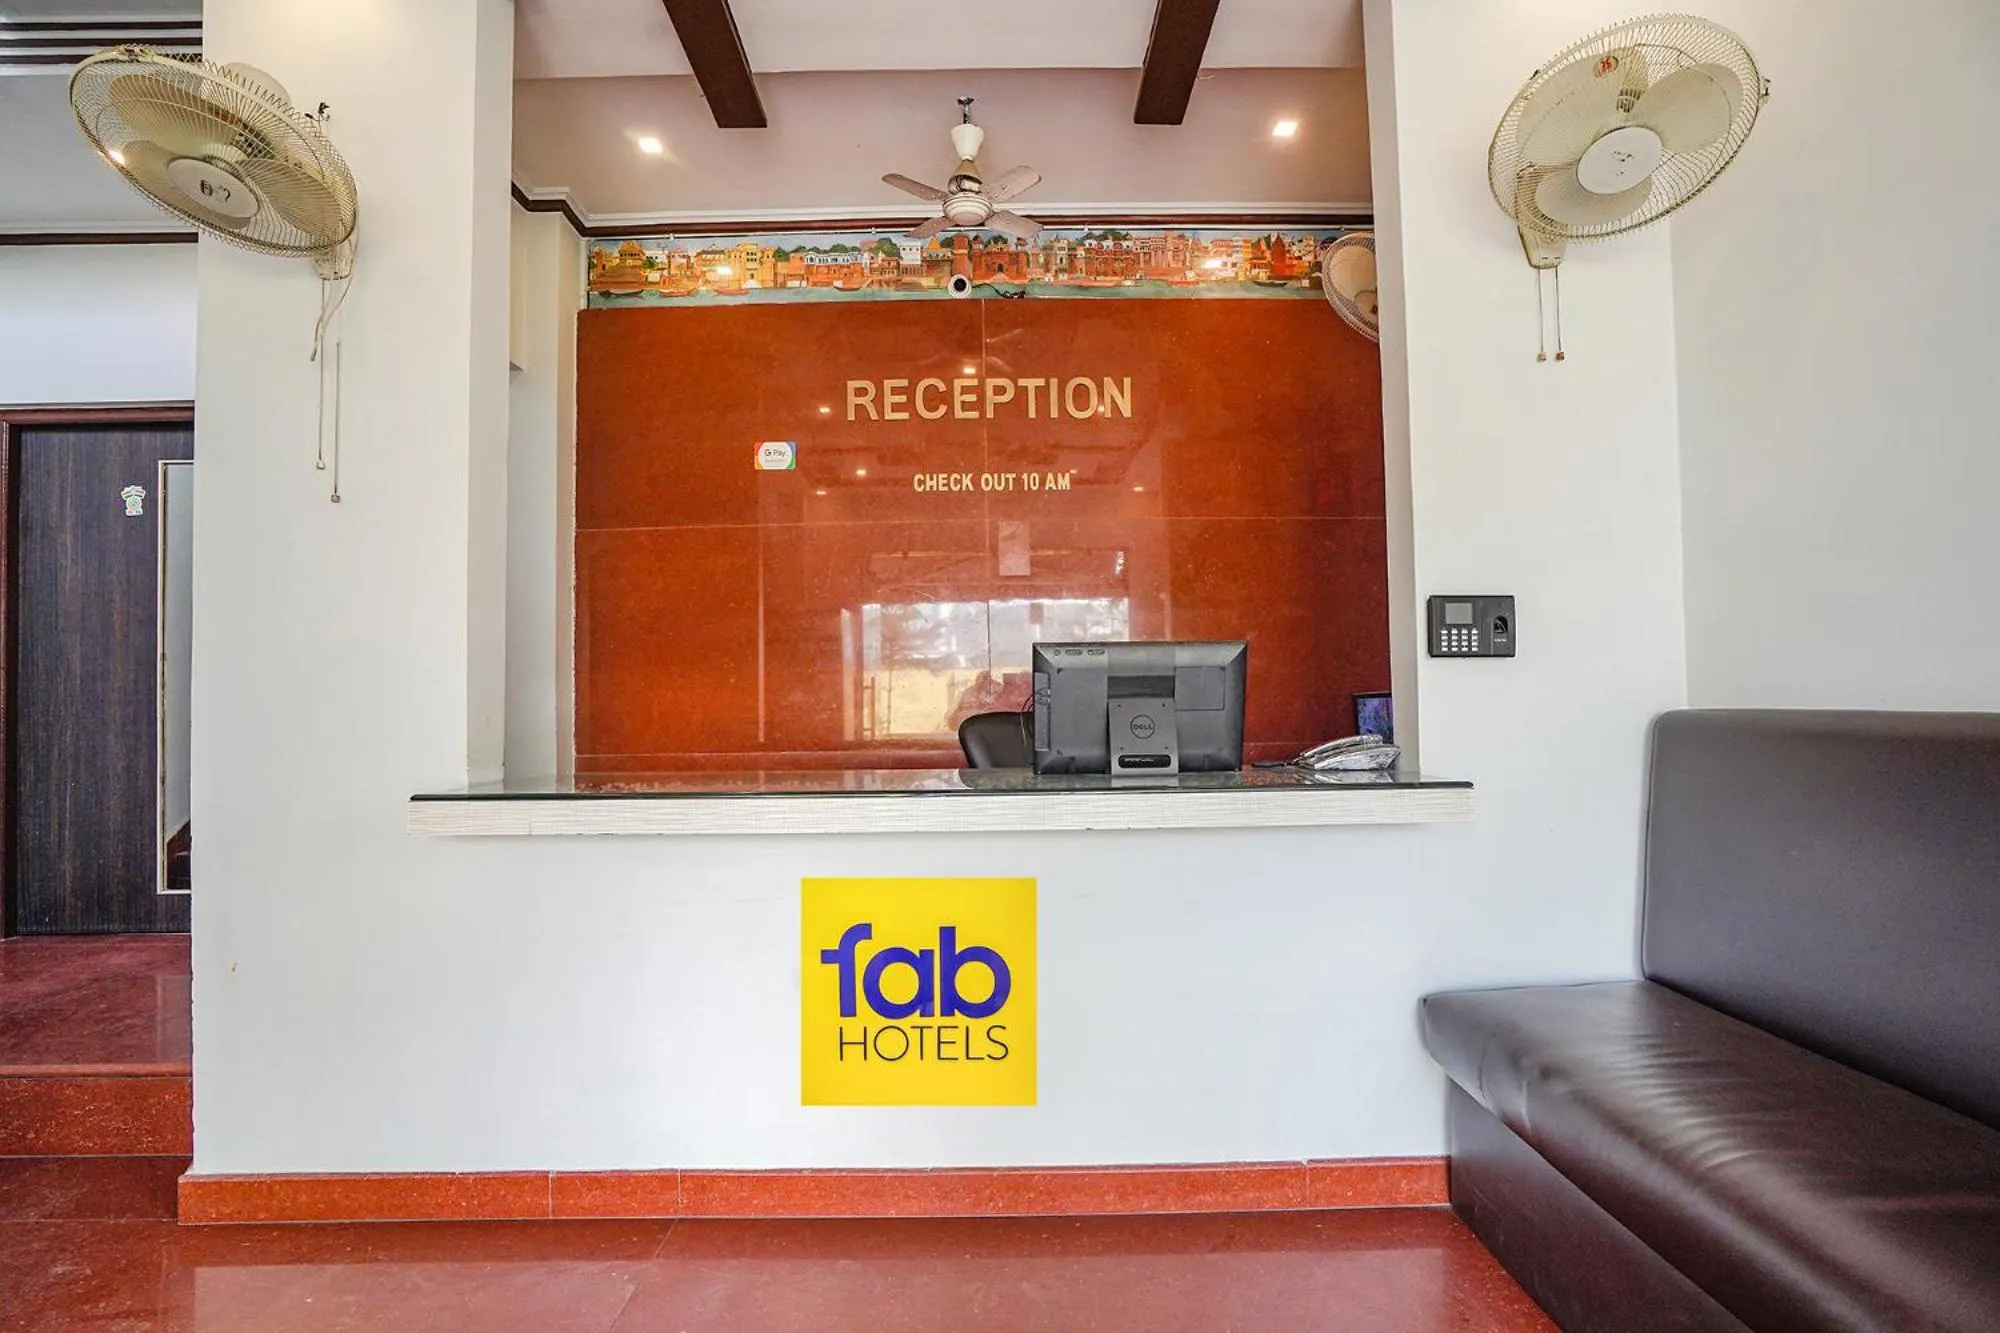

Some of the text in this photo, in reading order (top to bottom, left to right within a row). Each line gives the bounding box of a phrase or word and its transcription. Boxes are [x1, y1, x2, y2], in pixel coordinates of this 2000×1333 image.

[846, 376, 1133, 422] RECEPTION
[913, 471, 1071, 492] CHECK OUT 10 AM
[1132, 723, 1153, 731] DELL
[820, 922, 1012, 1020] fab
[839, 1024, 1010, 1062] HOTELS
